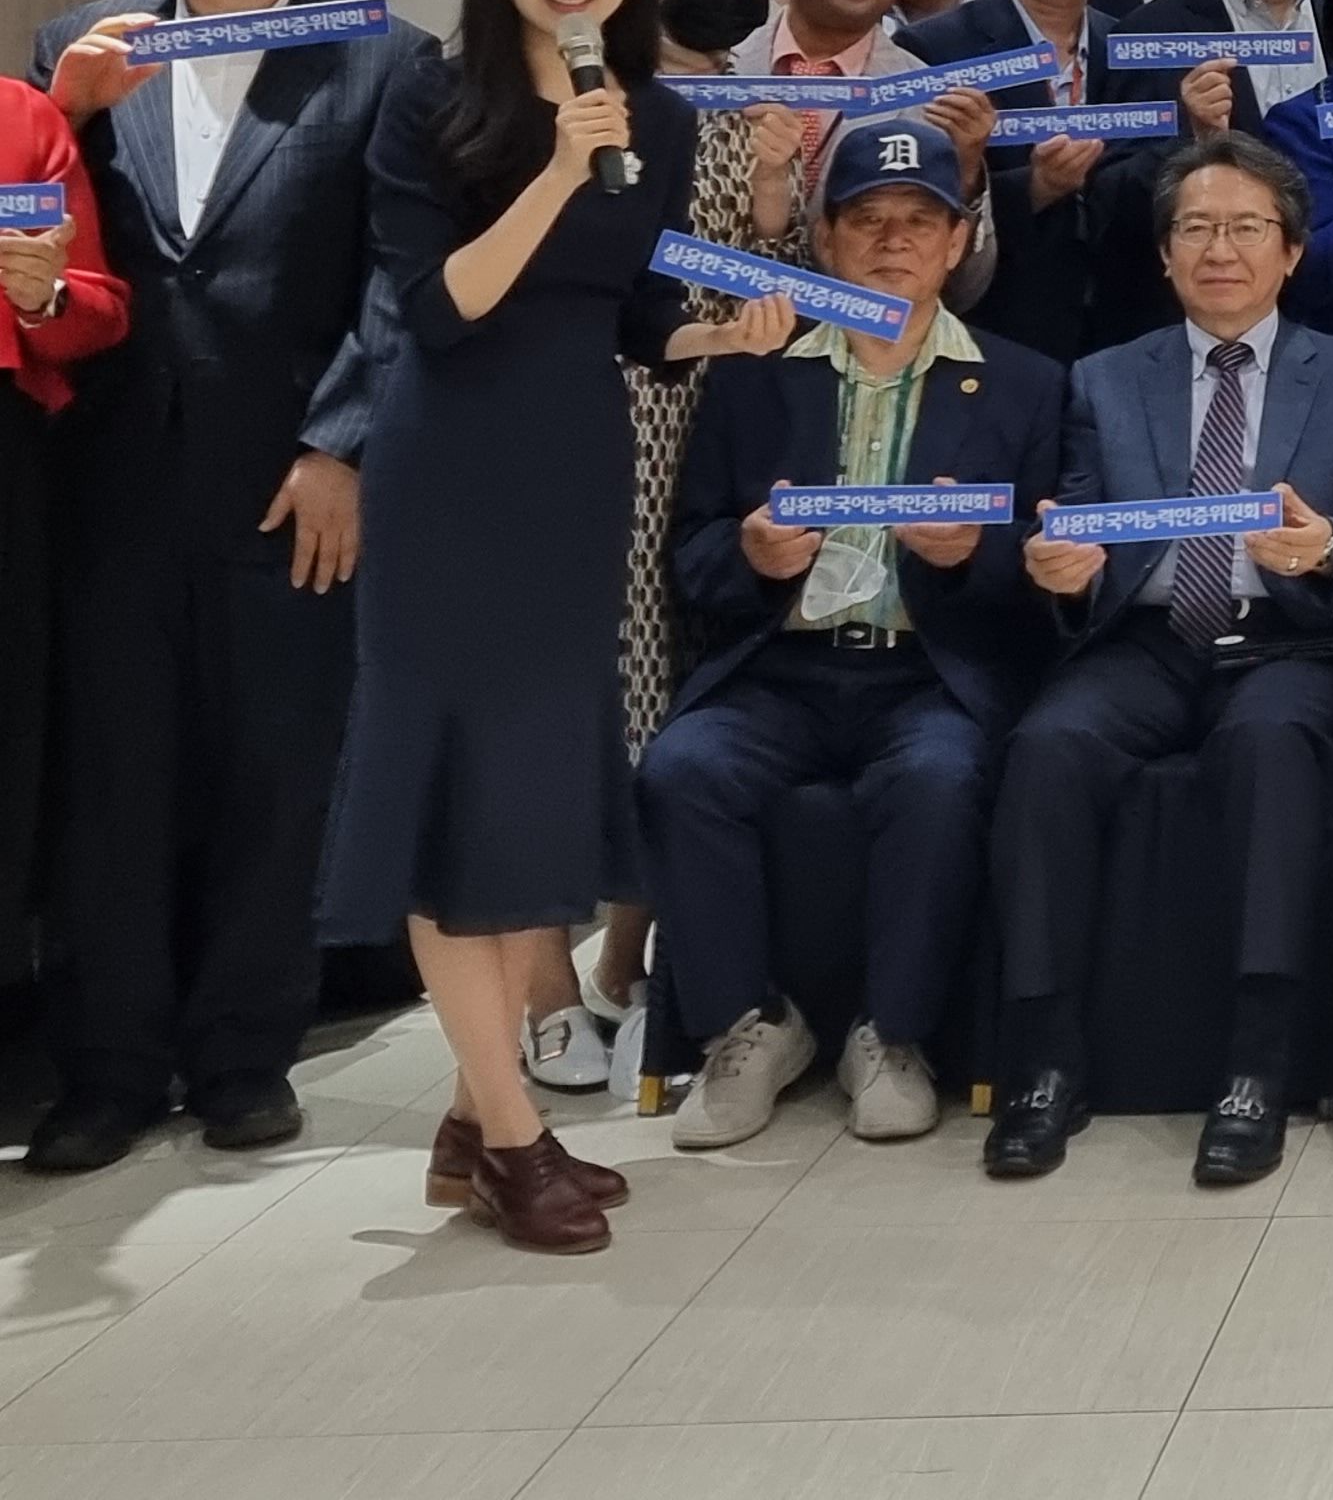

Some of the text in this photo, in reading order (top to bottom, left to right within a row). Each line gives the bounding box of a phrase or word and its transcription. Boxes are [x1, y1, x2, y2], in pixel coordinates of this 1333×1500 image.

[131, 8, 367, 56] 실용한국어능력인증위원회
[1114, 39, 1297, 60] 실용한국어능력인증위원회
[879, 134, 920, 170] D
[662, 241, 883, 323] 실용한국어능력인증위원회
[778, 492, 991, 517] 실용한국어능력인증위원회
[1050, 501, 1261, 536] 실용한국어능력인증위원회
